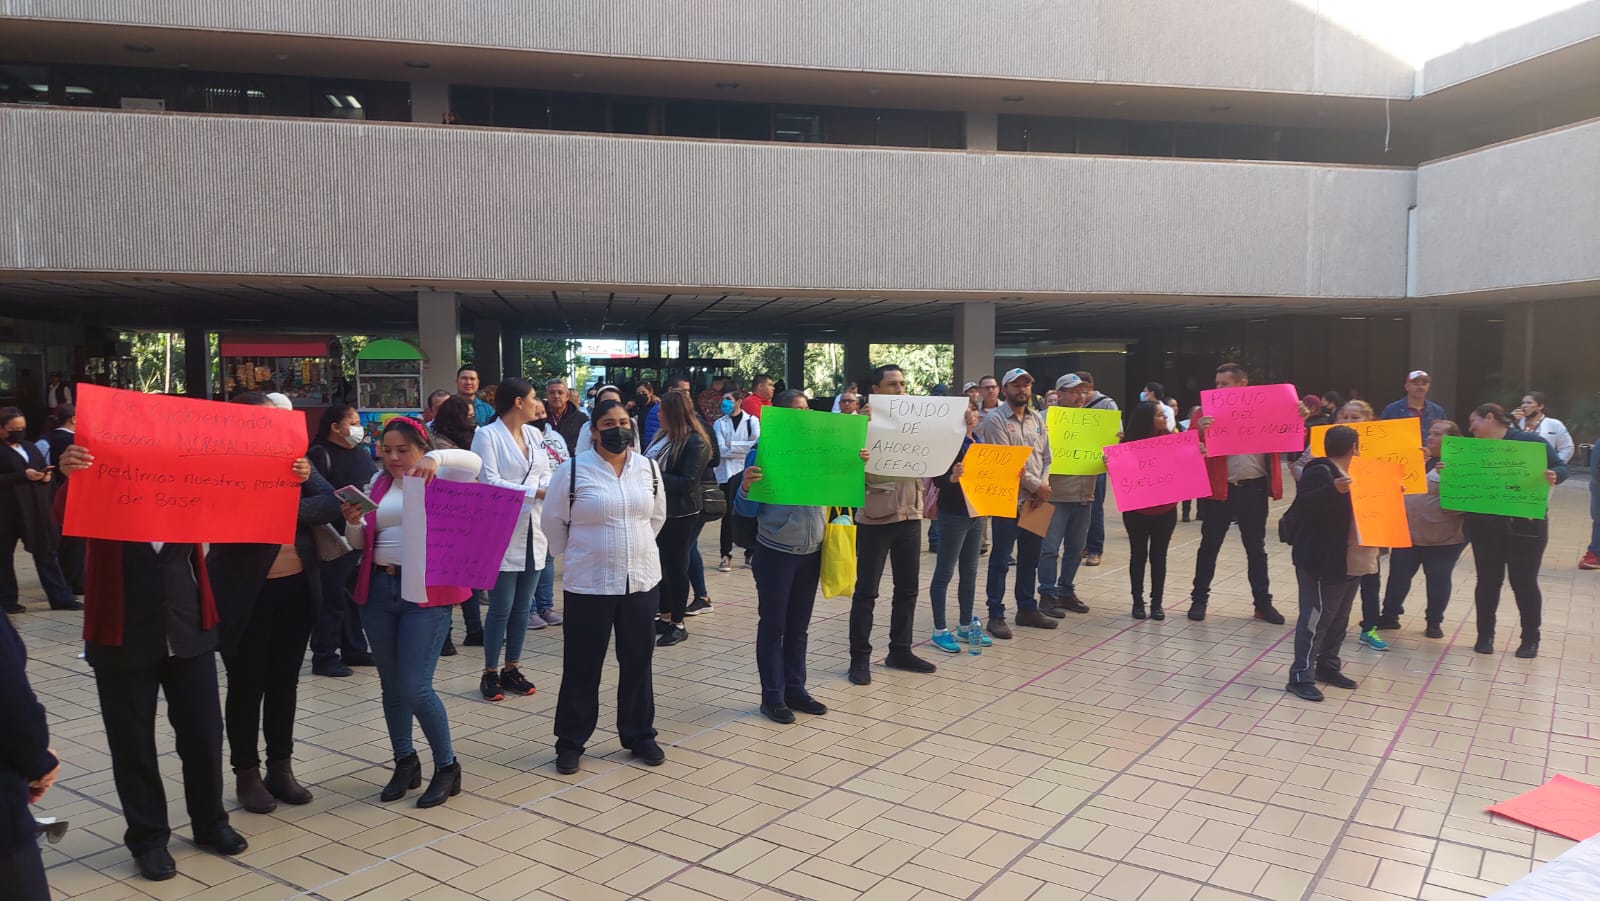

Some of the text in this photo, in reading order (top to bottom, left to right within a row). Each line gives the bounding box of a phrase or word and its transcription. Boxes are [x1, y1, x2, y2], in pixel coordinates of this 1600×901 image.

[889, 398, 950, 418] FONDO
[1212, 391, 1265, 408] BONO
[1054, 411, 1100, 426] VALES
[1232, 410, 1256, 420] DEL
[902, 421, 921, 435] DE
[1064, 431, 1080, 440] DE
[872, 439, 930, 457] AHORRO
[977, 447, 1012, 466] BONO
[874, 456, 928, 476] (FEAC)
[1139, 457, 1157, 469] DE
[118, 489, 201, 508] de Base
